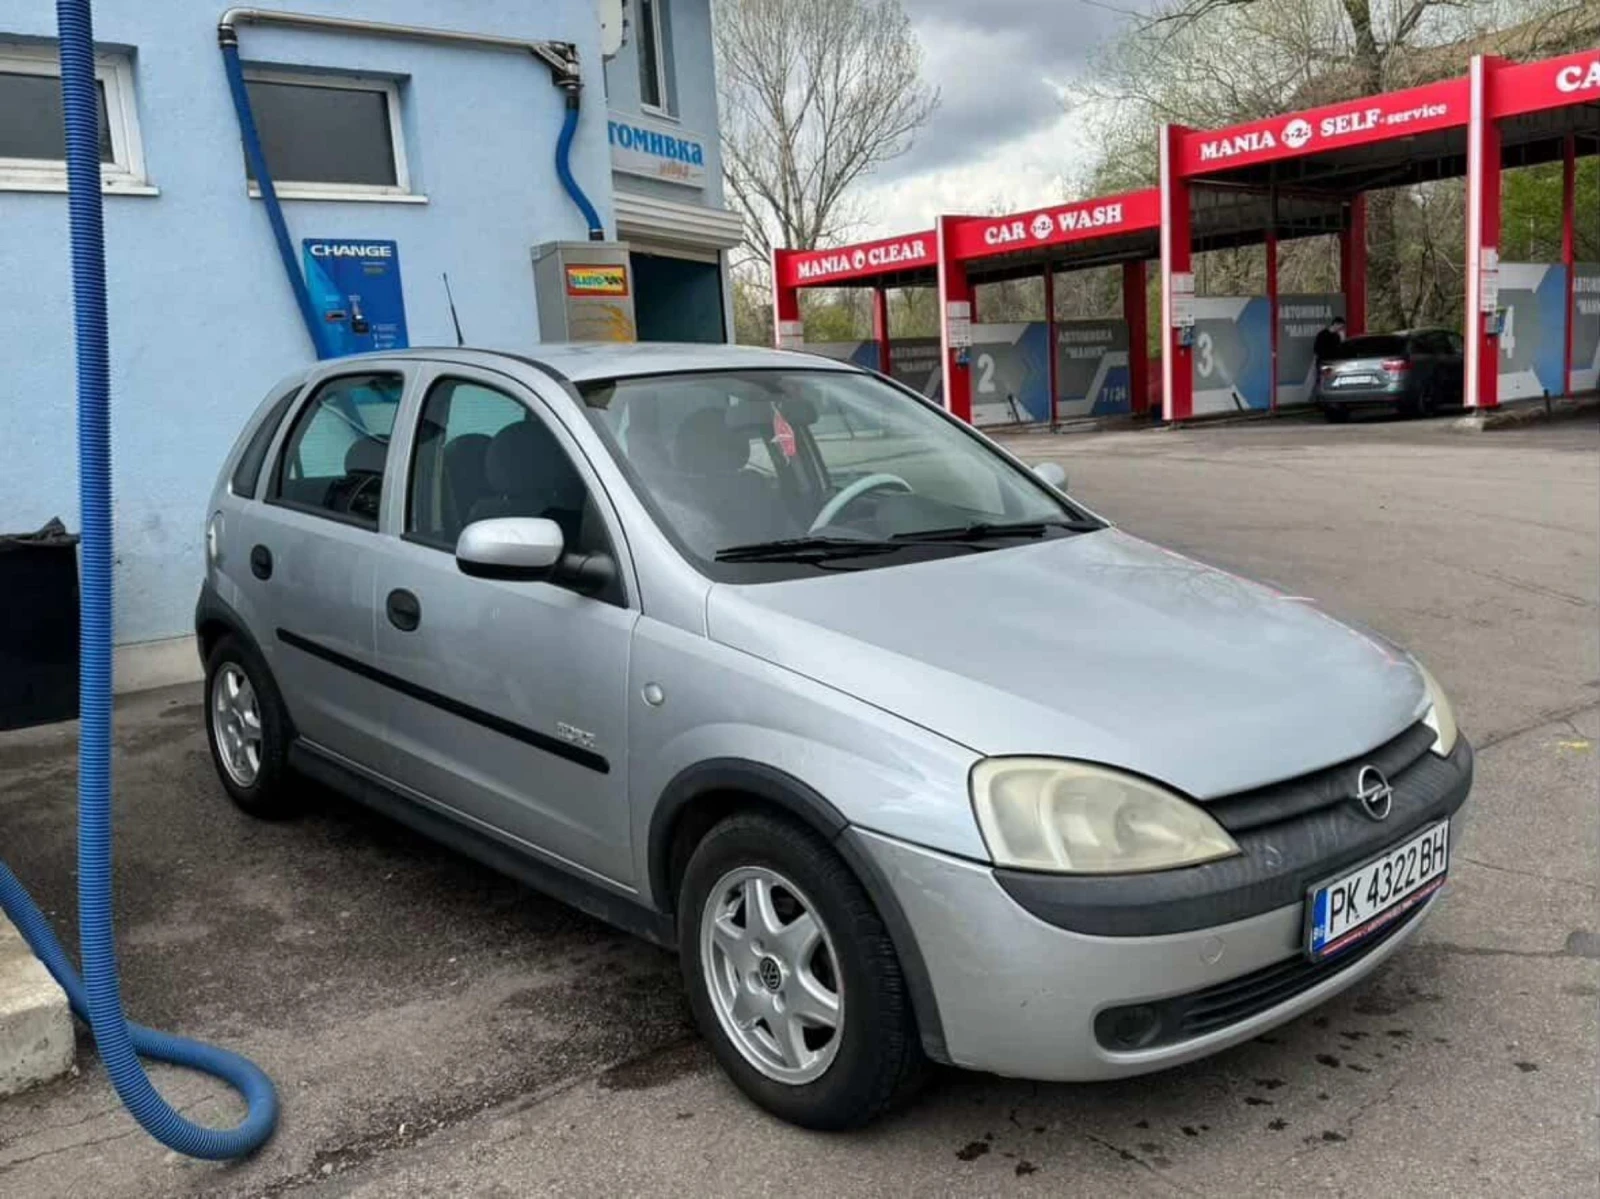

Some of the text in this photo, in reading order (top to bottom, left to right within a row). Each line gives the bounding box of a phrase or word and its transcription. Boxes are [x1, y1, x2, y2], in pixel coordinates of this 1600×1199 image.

[1200, 129, 1276, 162] MANIA
[984, 221, 1026, 245] CAR
[1058, 203, 1122, 232] WASH
[310, 244, 392, 257] CHANGE
[797, 240, 926, 279] MANIA CLEAR
[1500, 304, 1516, 359] 4
[976, 353, 996, 394] 2
[1197, 332, 1214, 378] 3
[1329, 828, 1445, 934] PK 4322 BH
